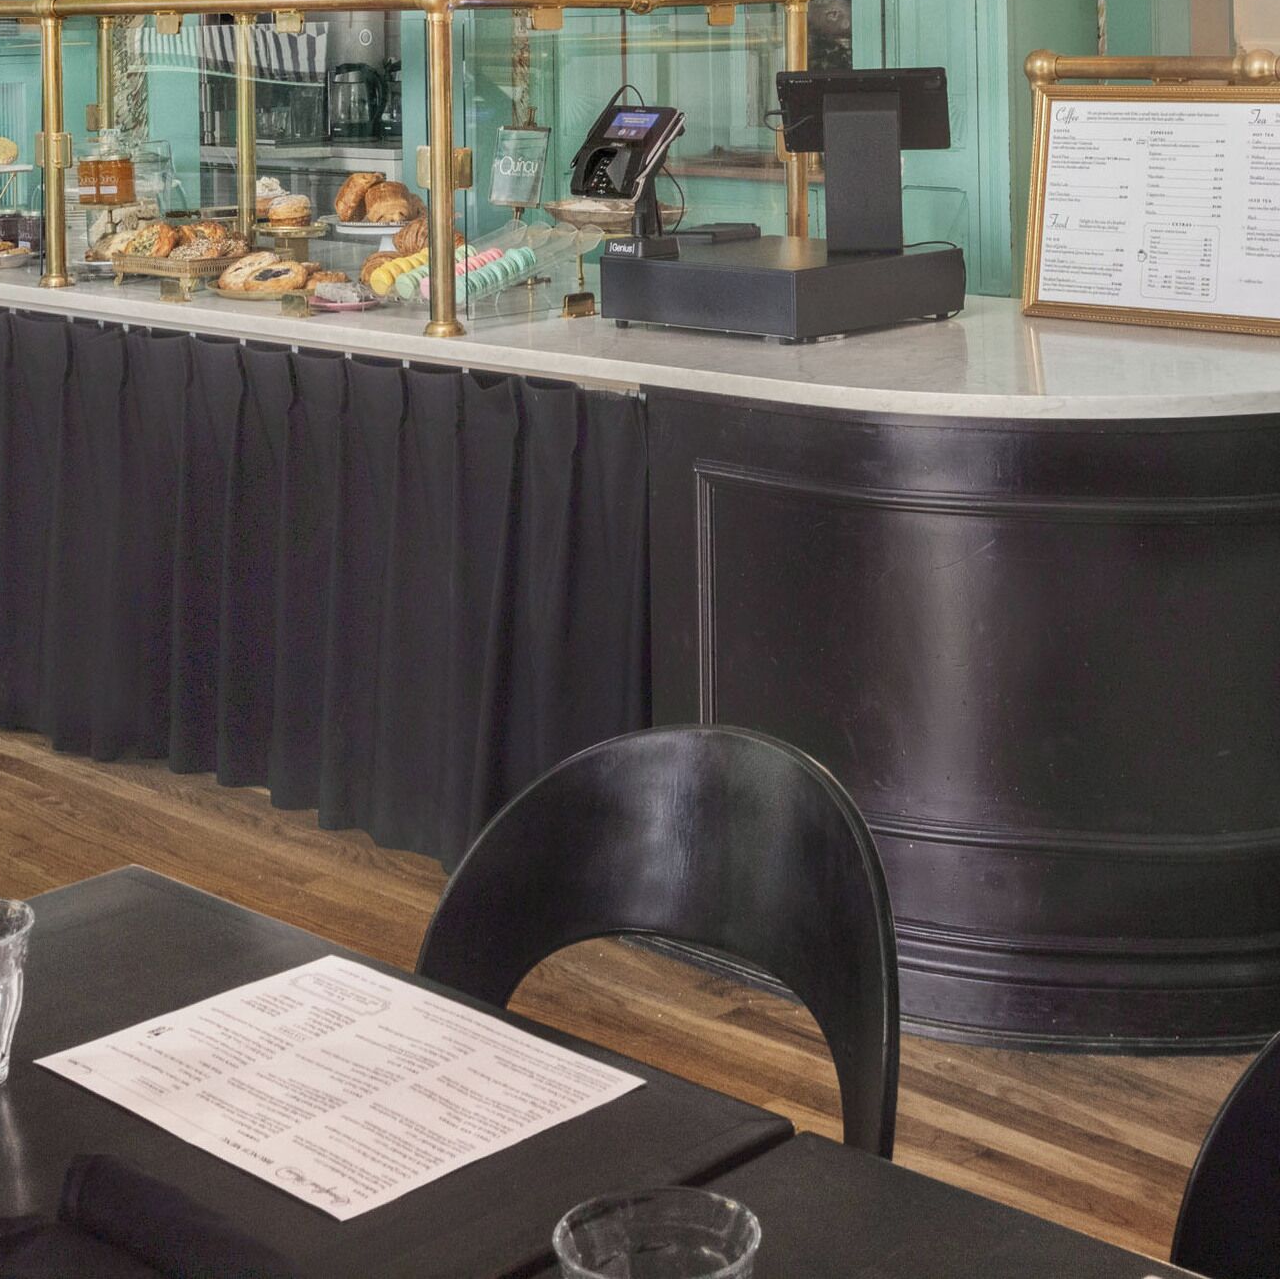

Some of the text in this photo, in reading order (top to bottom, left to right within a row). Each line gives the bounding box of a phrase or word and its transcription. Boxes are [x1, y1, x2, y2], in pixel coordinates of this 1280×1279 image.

[1055, 107, 1079, 125] Coffee
[1247, 108, 1266, 124] Tea
[500, 155, 539, 176] Quincy
[1049, 213, 1070, 229] Food
